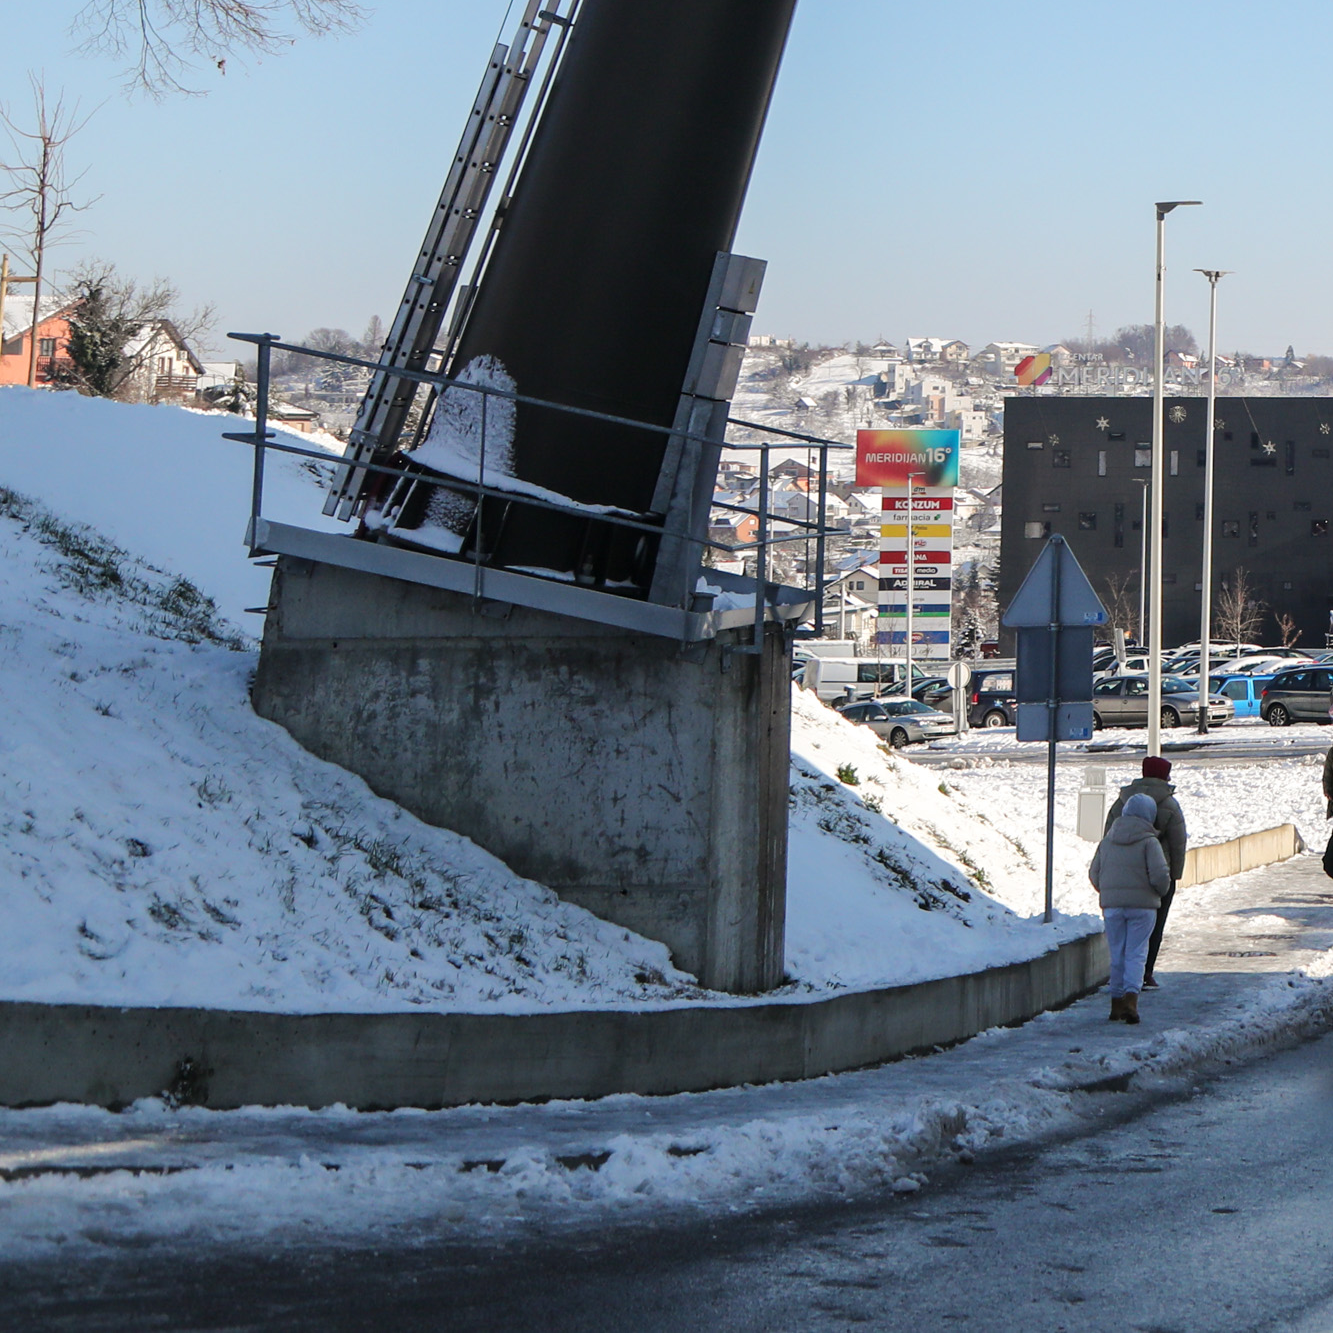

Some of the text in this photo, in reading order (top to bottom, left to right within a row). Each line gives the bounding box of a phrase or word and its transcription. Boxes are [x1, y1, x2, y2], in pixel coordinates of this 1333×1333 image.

[1058, 366, 1200, 386] MERIDIAN
[865, 447, 952, 463] MERIDIJAN 16°
[893, 579, 937, 587] ADIRAL
